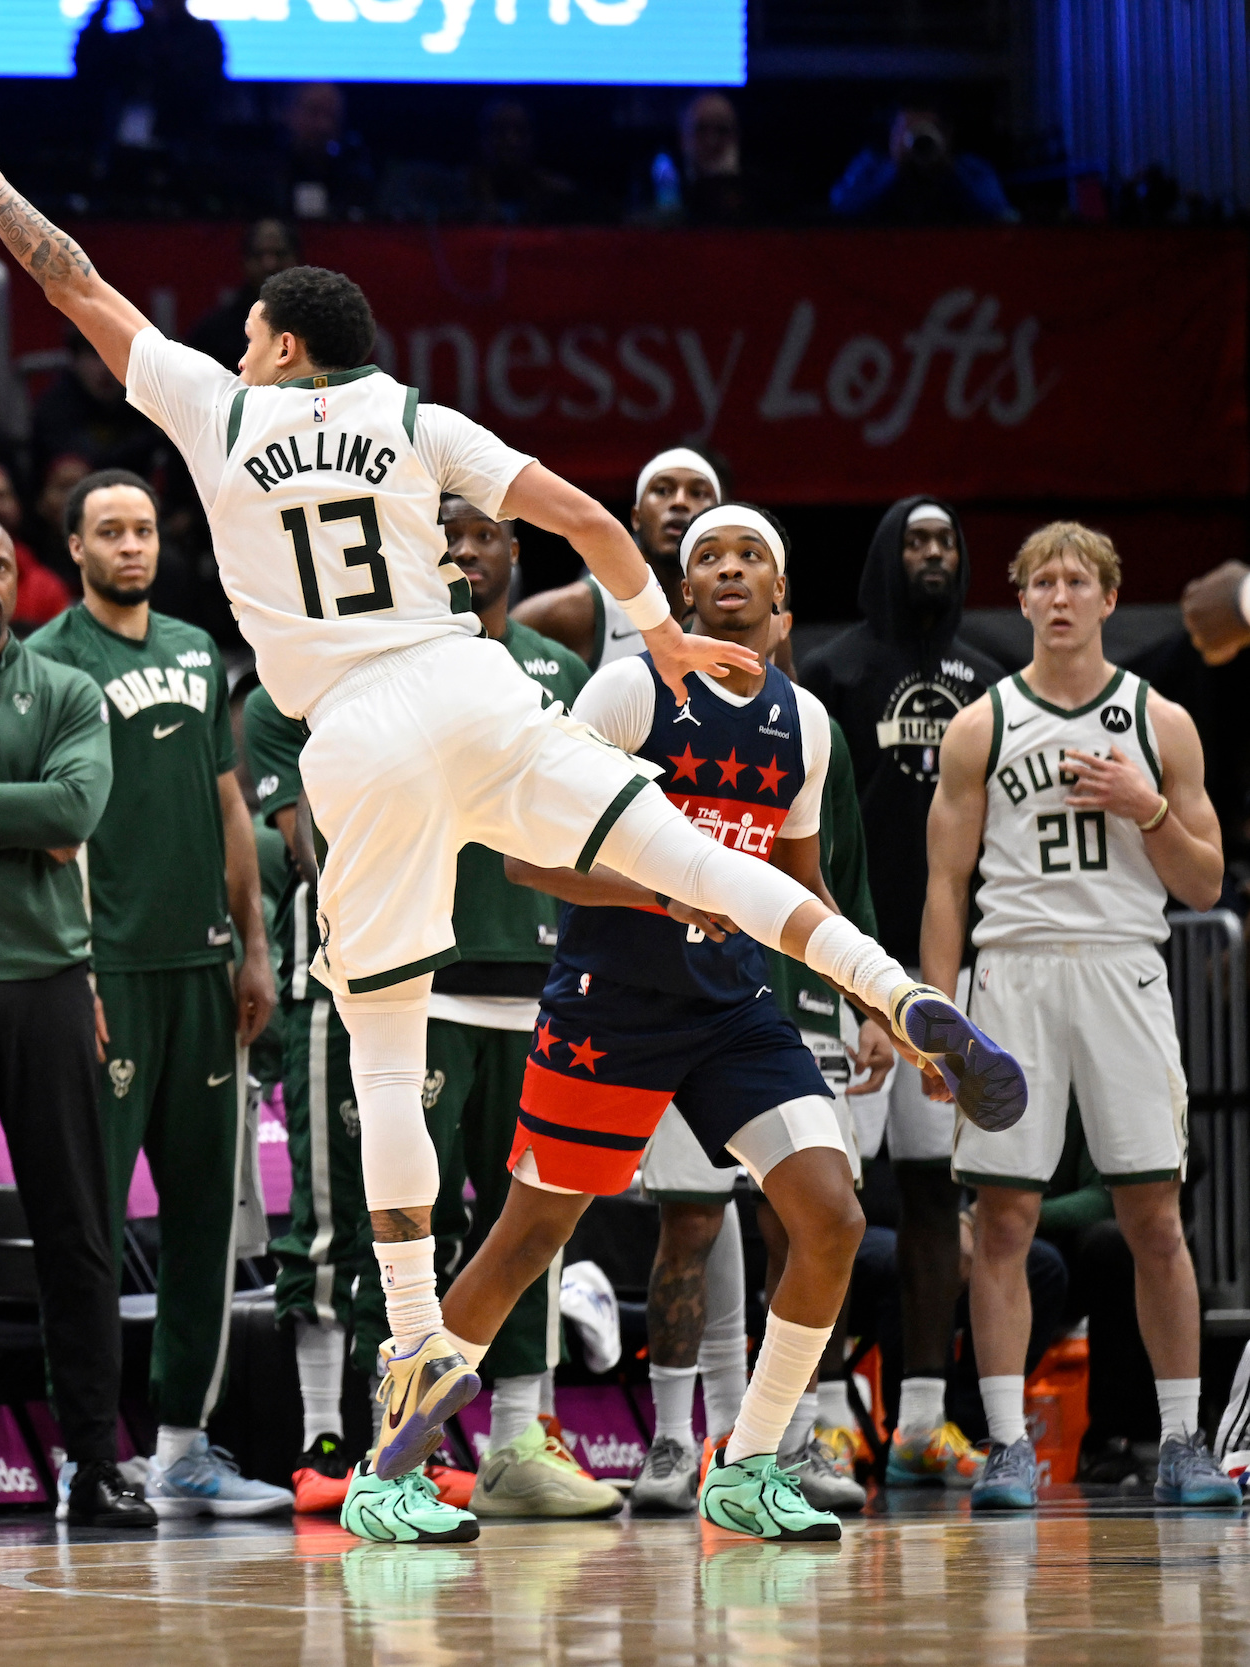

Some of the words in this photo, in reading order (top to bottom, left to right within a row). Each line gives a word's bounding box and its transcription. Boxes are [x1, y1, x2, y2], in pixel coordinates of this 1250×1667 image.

[758, 285, 1064, 449] Lofts
[243, 431, 396, 493] ROLLINS
[279, 497, 395, 620] 13
[104, 666, 208, 720] BUCKS
[758, 724, 791, 740] Robinhood
[681, 800, 776, 855] strict
[697, 806, 720, 820] THE
[1037, 811, 1108, 873] 20
